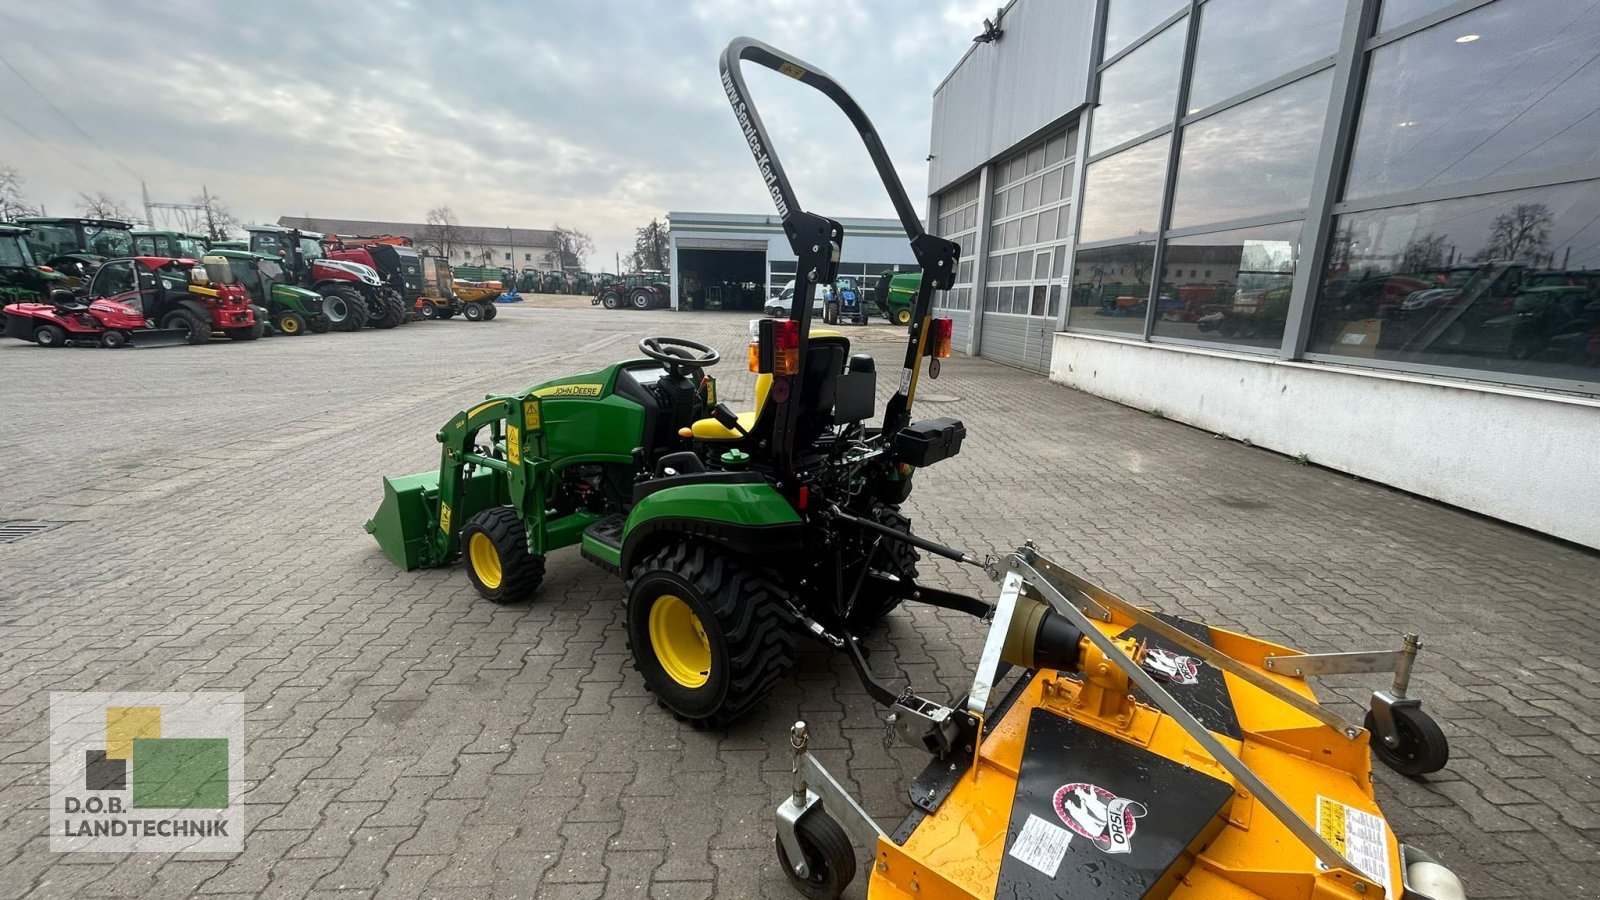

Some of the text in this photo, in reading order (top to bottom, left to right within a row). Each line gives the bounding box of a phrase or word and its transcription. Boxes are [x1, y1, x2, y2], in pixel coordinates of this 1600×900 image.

[721, 70, 788, 220] www.Service-Karl.com
[554, 386, 597, 395] JOHN DEERE
[1109, 811, 1125, 844] ORSI
